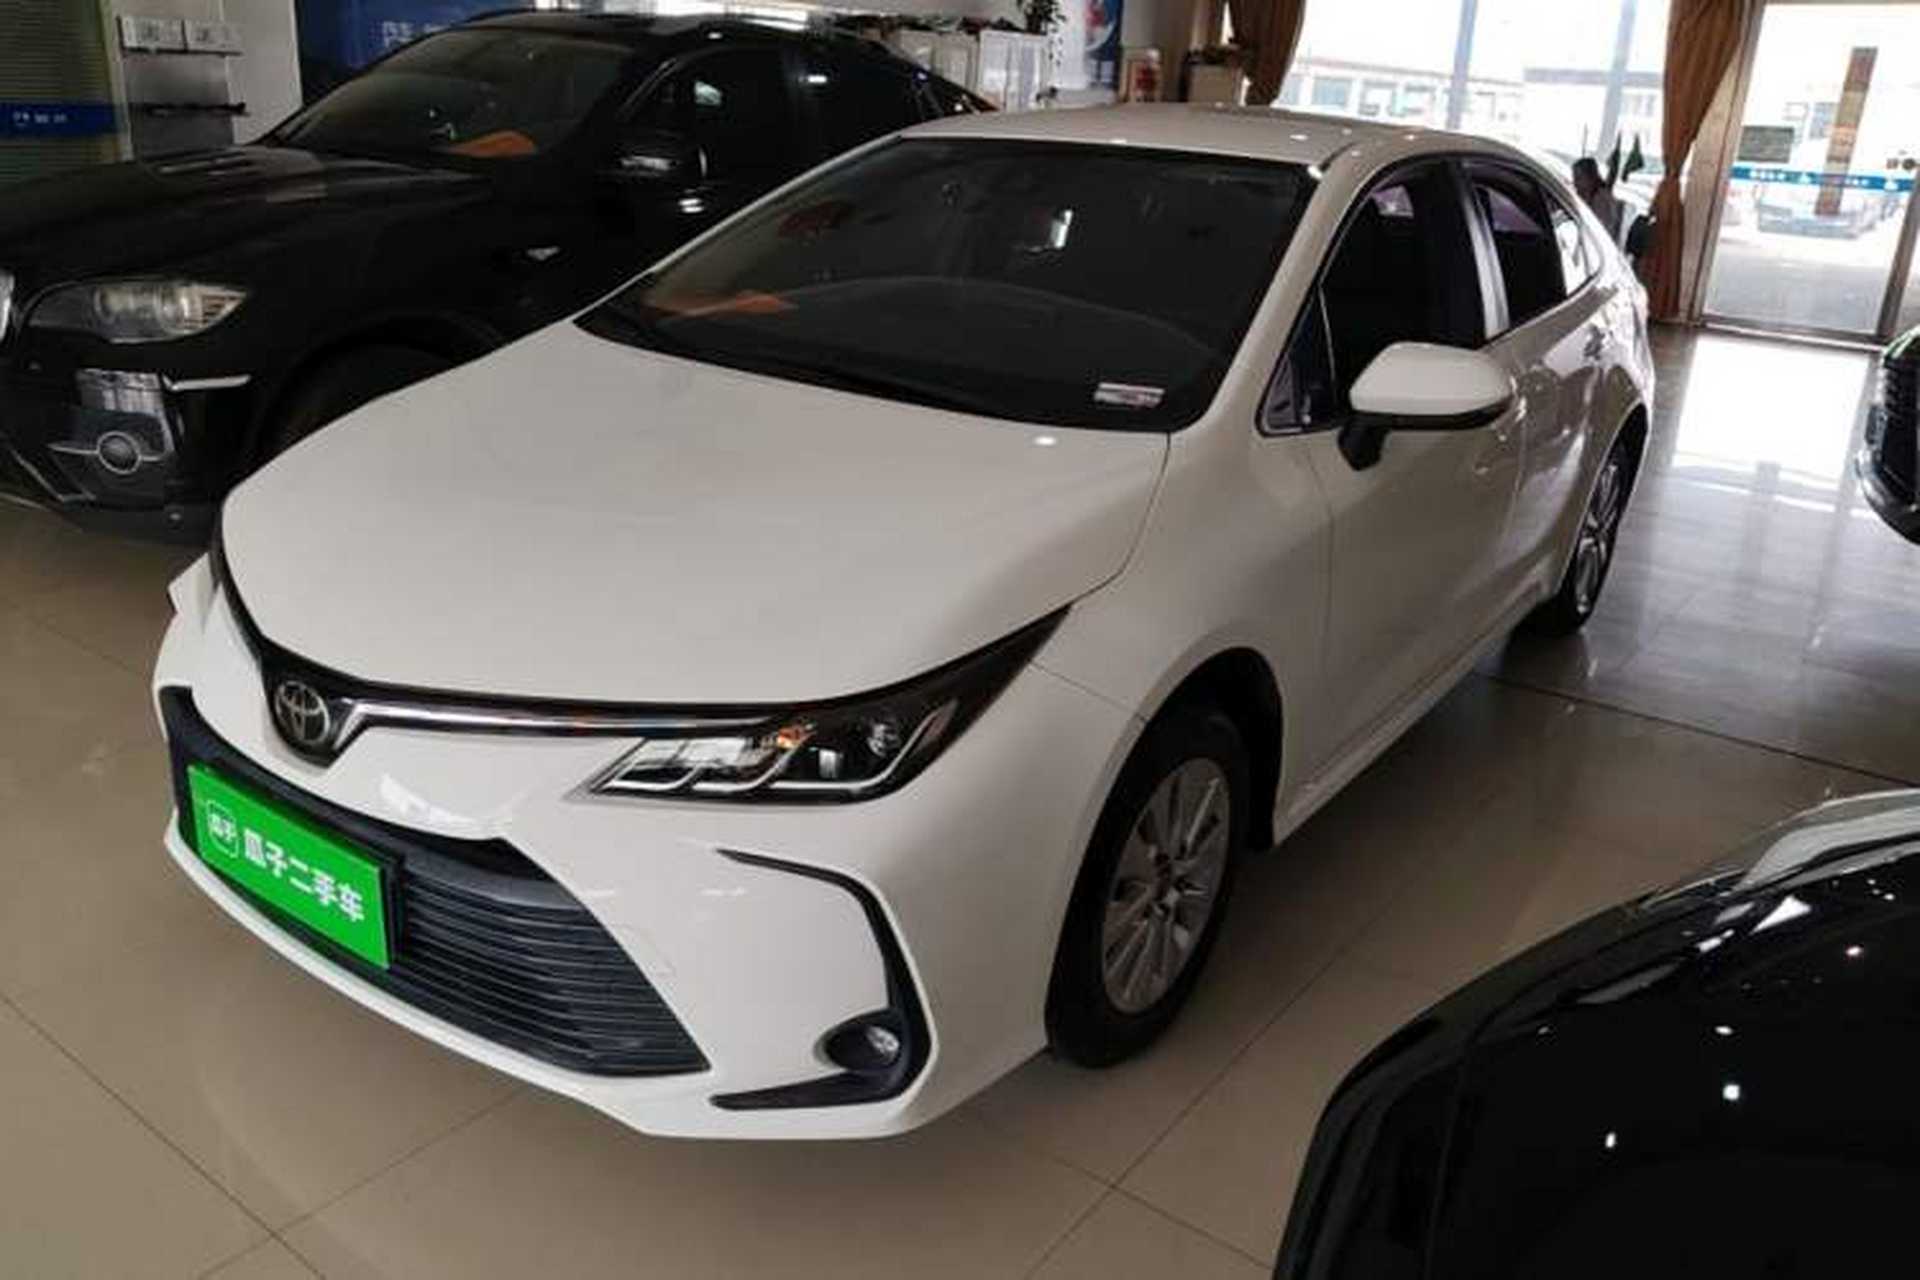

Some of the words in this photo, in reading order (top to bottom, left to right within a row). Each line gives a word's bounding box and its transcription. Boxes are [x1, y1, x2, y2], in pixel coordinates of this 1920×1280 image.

[244, 828, 365, 923] 瓜子二手车
